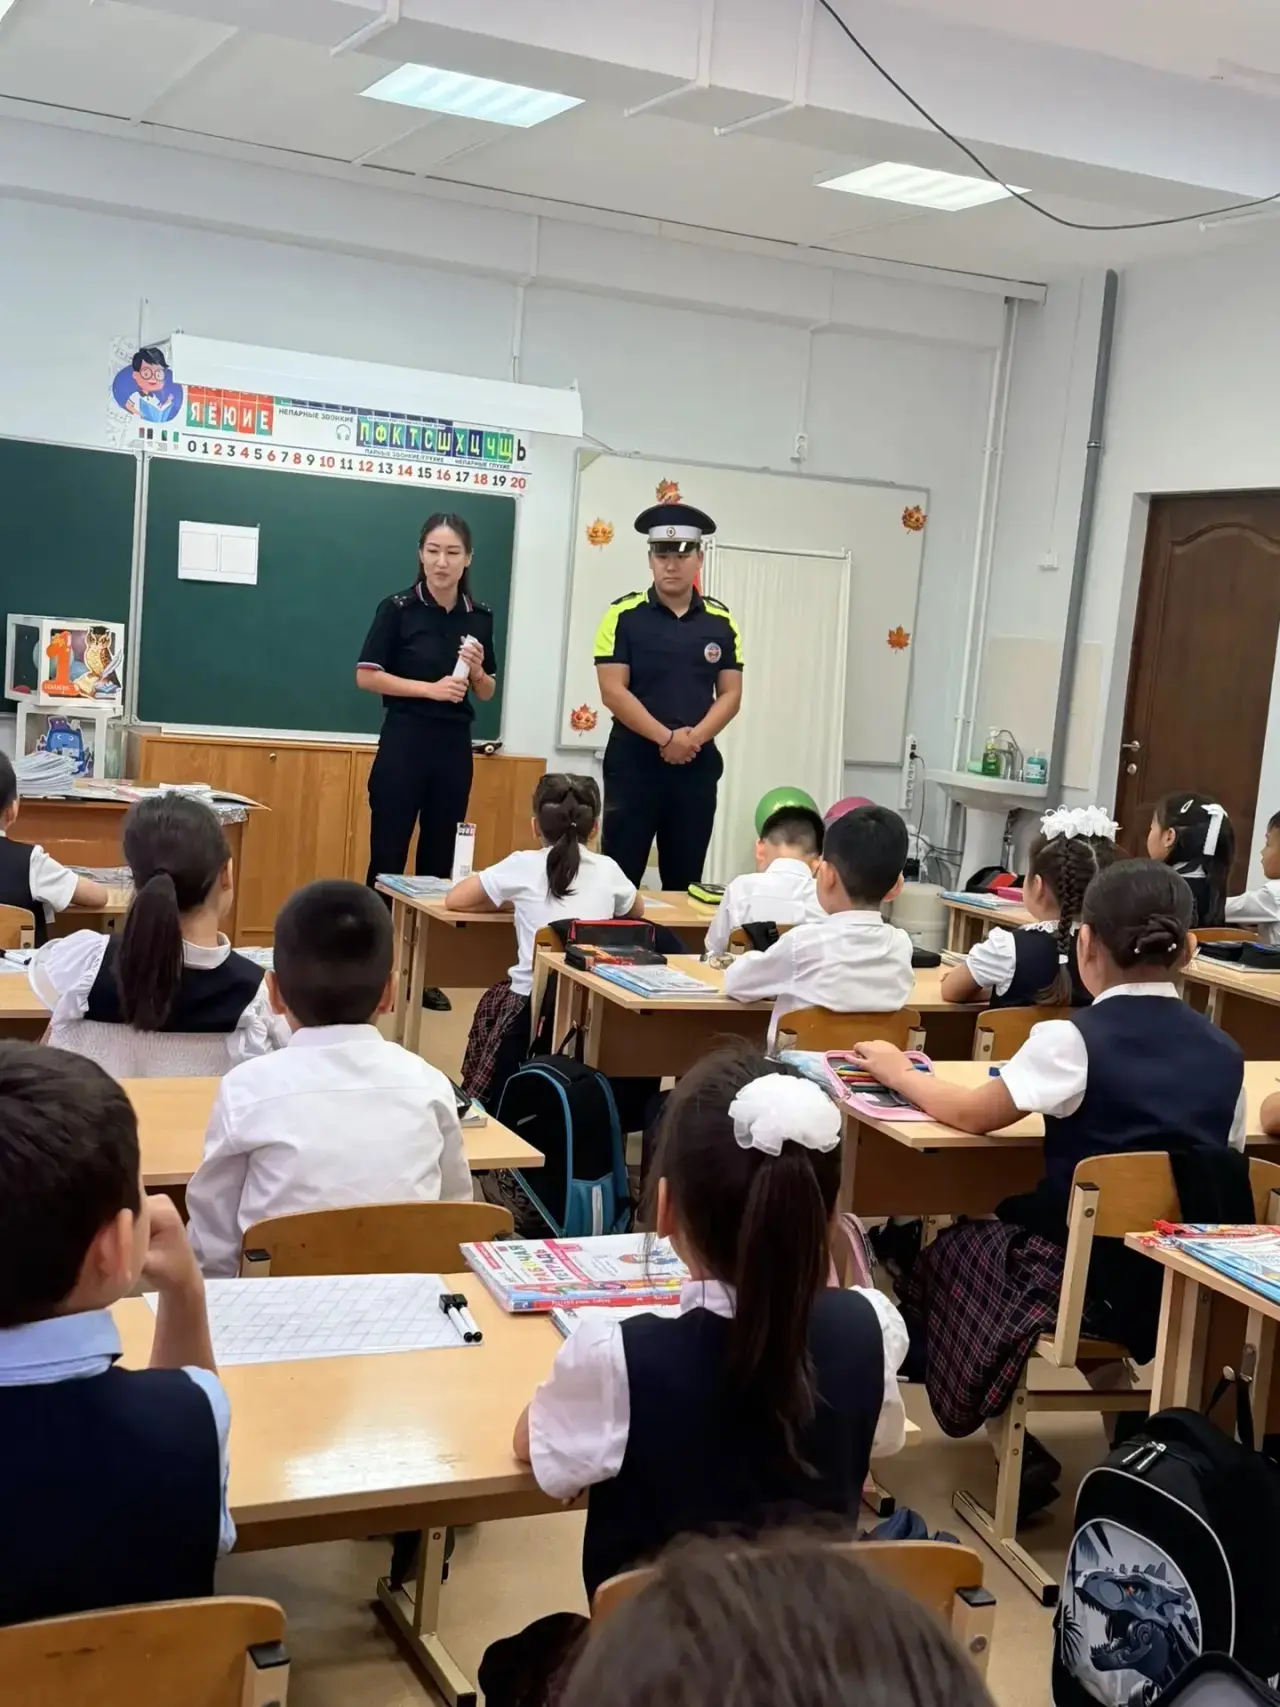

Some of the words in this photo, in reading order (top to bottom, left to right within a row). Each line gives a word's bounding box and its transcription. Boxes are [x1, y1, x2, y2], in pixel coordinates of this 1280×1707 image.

[190, 402, 200, 422] Я
[208, 401, 217, 425] Ё
[224, 405, 237, 426] Ю
[242, 408, 252, 428] И
[261, 410, 269, 430] Е
[278, 408, 320, 420] НЕПАРНЫЕ
[321, 413, 354, 423] ЗВОНКИЕ
[360, 422, 370, 441] П
[375, 424, 387, 444] Ф
[392, 426, 401, 445] К
[410, 428, 419, 446] Т
[425, 429, 433, 448] С
[438, 432, 451, 451] Ш
[455, 433, 464, 453] Х
[471, 434, 480, 454] Ц
[487, 437, 495, 456] Ч
[500, 438, 512, 459] Щ
[364, 448, 390, 456] ПАРНЫЕ
[187, 440, 196, 452] 0
[202, 442, 209, 454] 1
[214, 443, 223, 456] 2
[227, 445, 236, 457] 3
[240, 447, 250, 458] 4
[254, 448, 262, 460] 5
[267, 450, 276, 462] 6
[281, 452, 289, 463] 7
[293, 452, 302, 464] 8
[306, 454, 315, 466] 9
[320, 456, 336, 468] 10
[340, 458, 353, 470] 11
[358, 460, 374, 472] 12
[378, 462, 393, 474] 13
[397, 464, 413, 477] 14
[417, 467, 432, 479] 15
[436, 469, 452, 481] 16
[456, 472, 470, 483] 17
[473, 473, 488, 485] 18
[492, 476, 506, 487] 19
[510, 477, 526, 490] 20
[454, 458, 488, 468] НЕПАРНЫЕ
[533, 1249, 573, 1280] ТЕТРАДЬ
